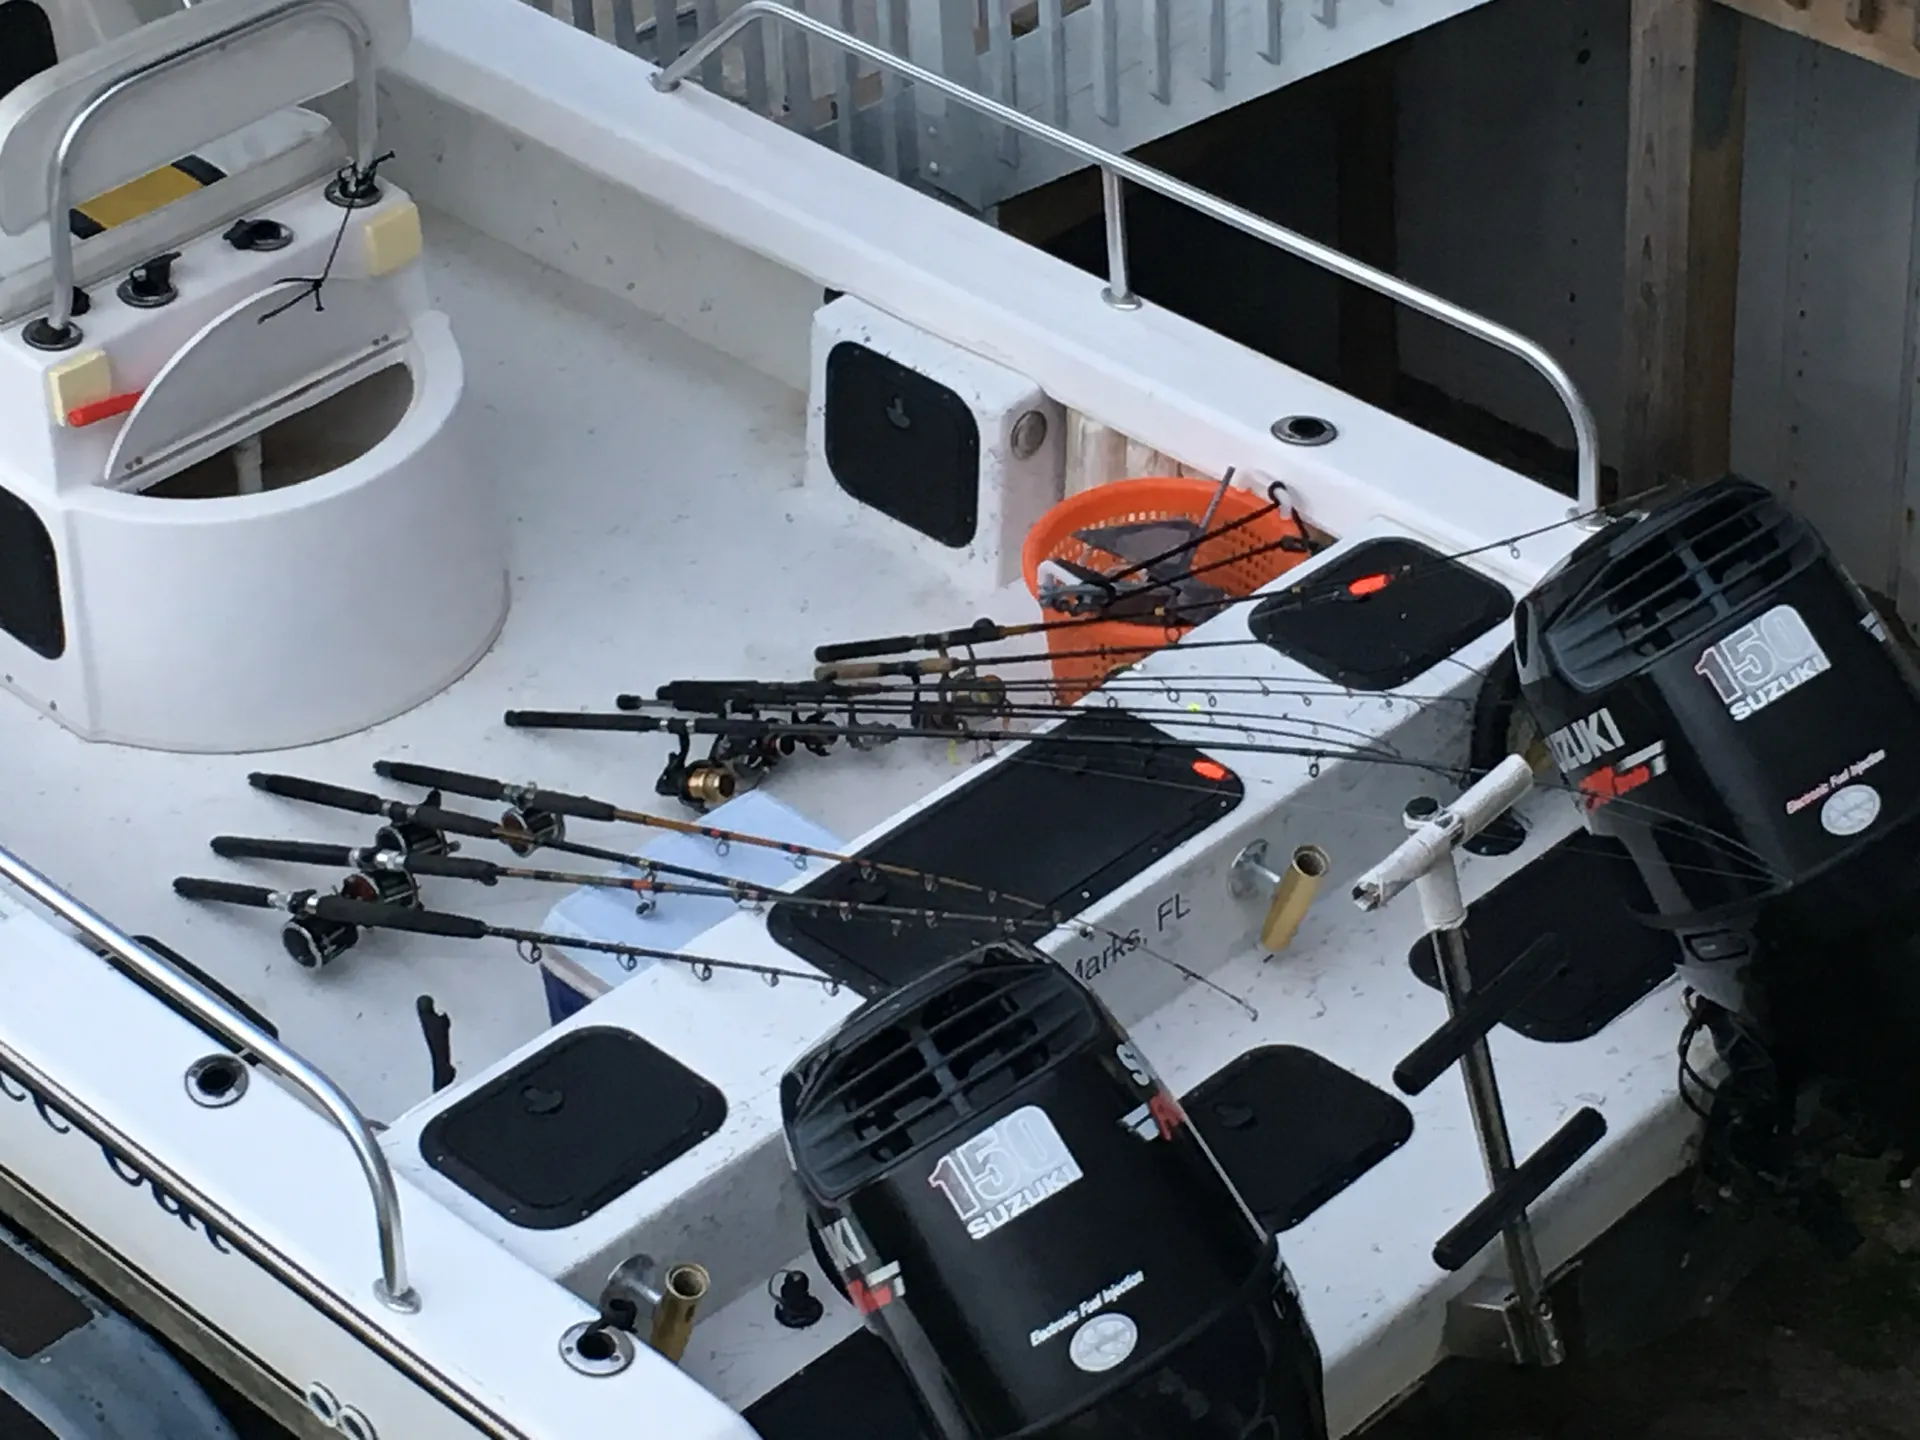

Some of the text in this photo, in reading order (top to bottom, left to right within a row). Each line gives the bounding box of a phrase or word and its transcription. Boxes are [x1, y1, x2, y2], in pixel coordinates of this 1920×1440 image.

[1695, 605, 1807, 704] 150
[1729, 655, 1831, 721] SUZUKI
[1545, 707, 1625, 774] ZUKI
[1157, 893, 1190, 932] FL
[928, 1105, 1055, 1220] 150
[966, 1161, 1084, 1240] SUZUKI
